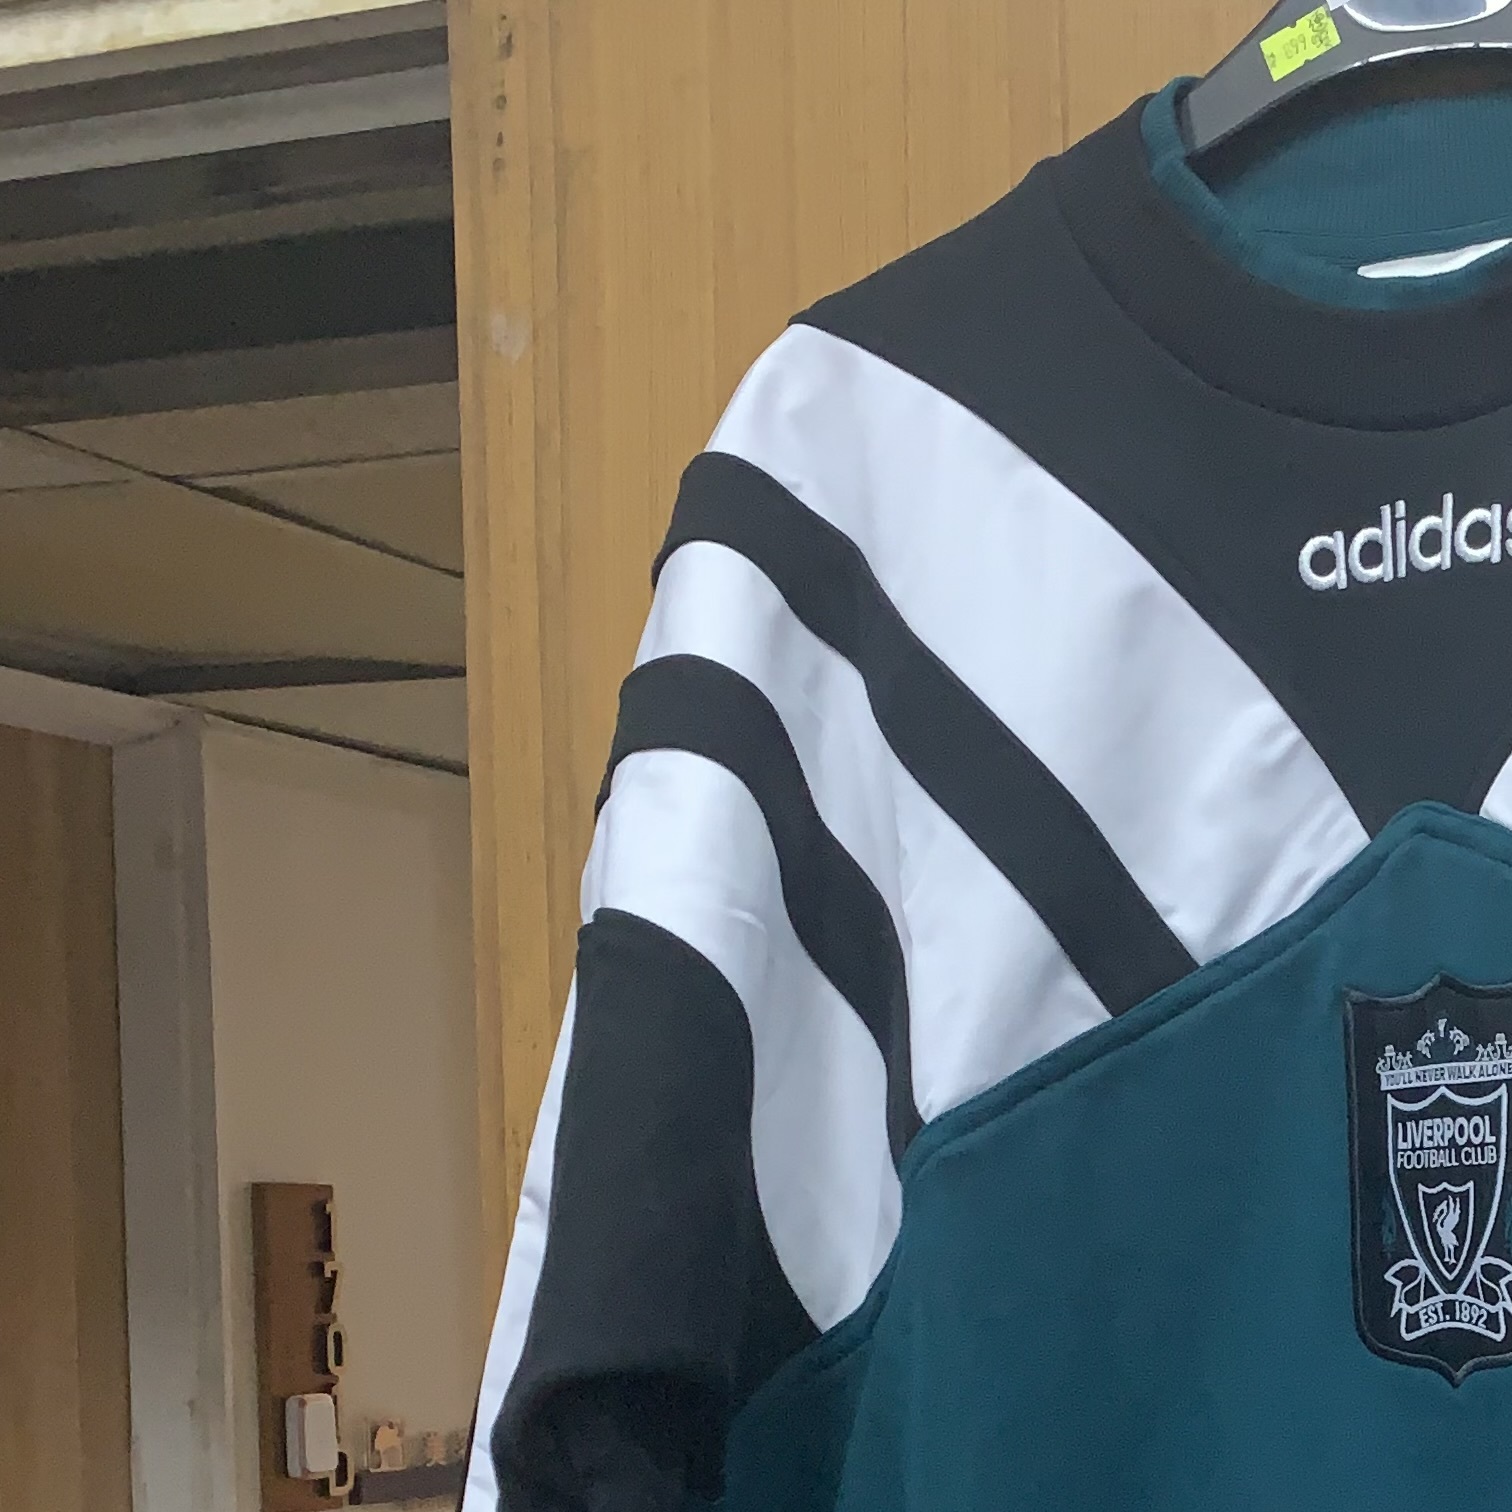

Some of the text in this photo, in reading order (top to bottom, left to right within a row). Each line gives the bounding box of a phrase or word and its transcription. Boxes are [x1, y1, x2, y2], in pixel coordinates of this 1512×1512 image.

[1415, 1069, 1446, 1083] NEVER
[1447, 1065, 1477, 1081] WALK
[1397, 1115, 1497, 1150] LIVERPOOL
[1396, 1145, 1498, 1170] FOOTBALL CLUB
[1418, 1300, 1488, 1329] EST. 1892
